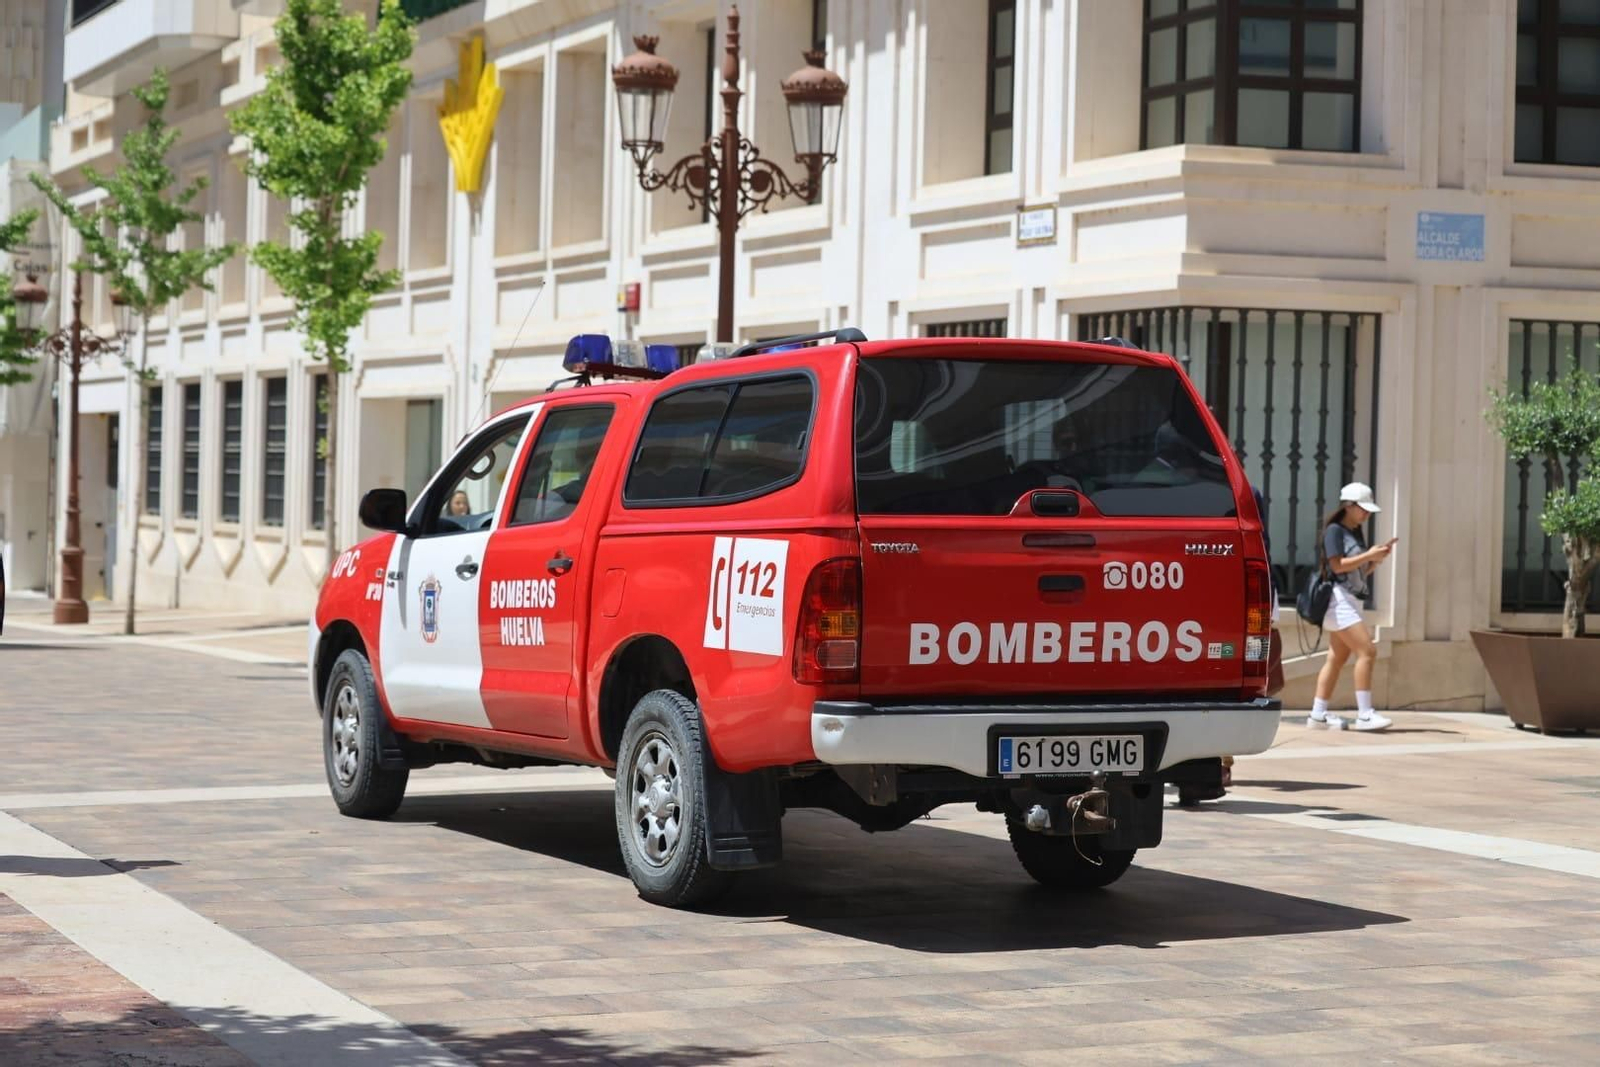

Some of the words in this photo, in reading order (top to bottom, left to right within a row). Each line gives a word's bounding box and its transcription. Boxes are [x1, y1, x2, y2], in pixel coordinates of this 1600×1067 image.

[871, 542, 920, 554] TOYOTA
[1185, 543, 1235, 556] HILUX
[332, 550, 360, 578] UPC
[1131, 561, 1184, 590] 080
[737, 560, 777, 598] 112
[490, 578, 556, 609] BOMBEROS
[736, 602, 776, 618] Emergencias
[501, 616, 545, 646] HUELVA
[908, 620, 1203, 665] BOMBEROS
[1016, 741, 1080, 768] 6199
[1090, 740, 1137, 766] GMG
